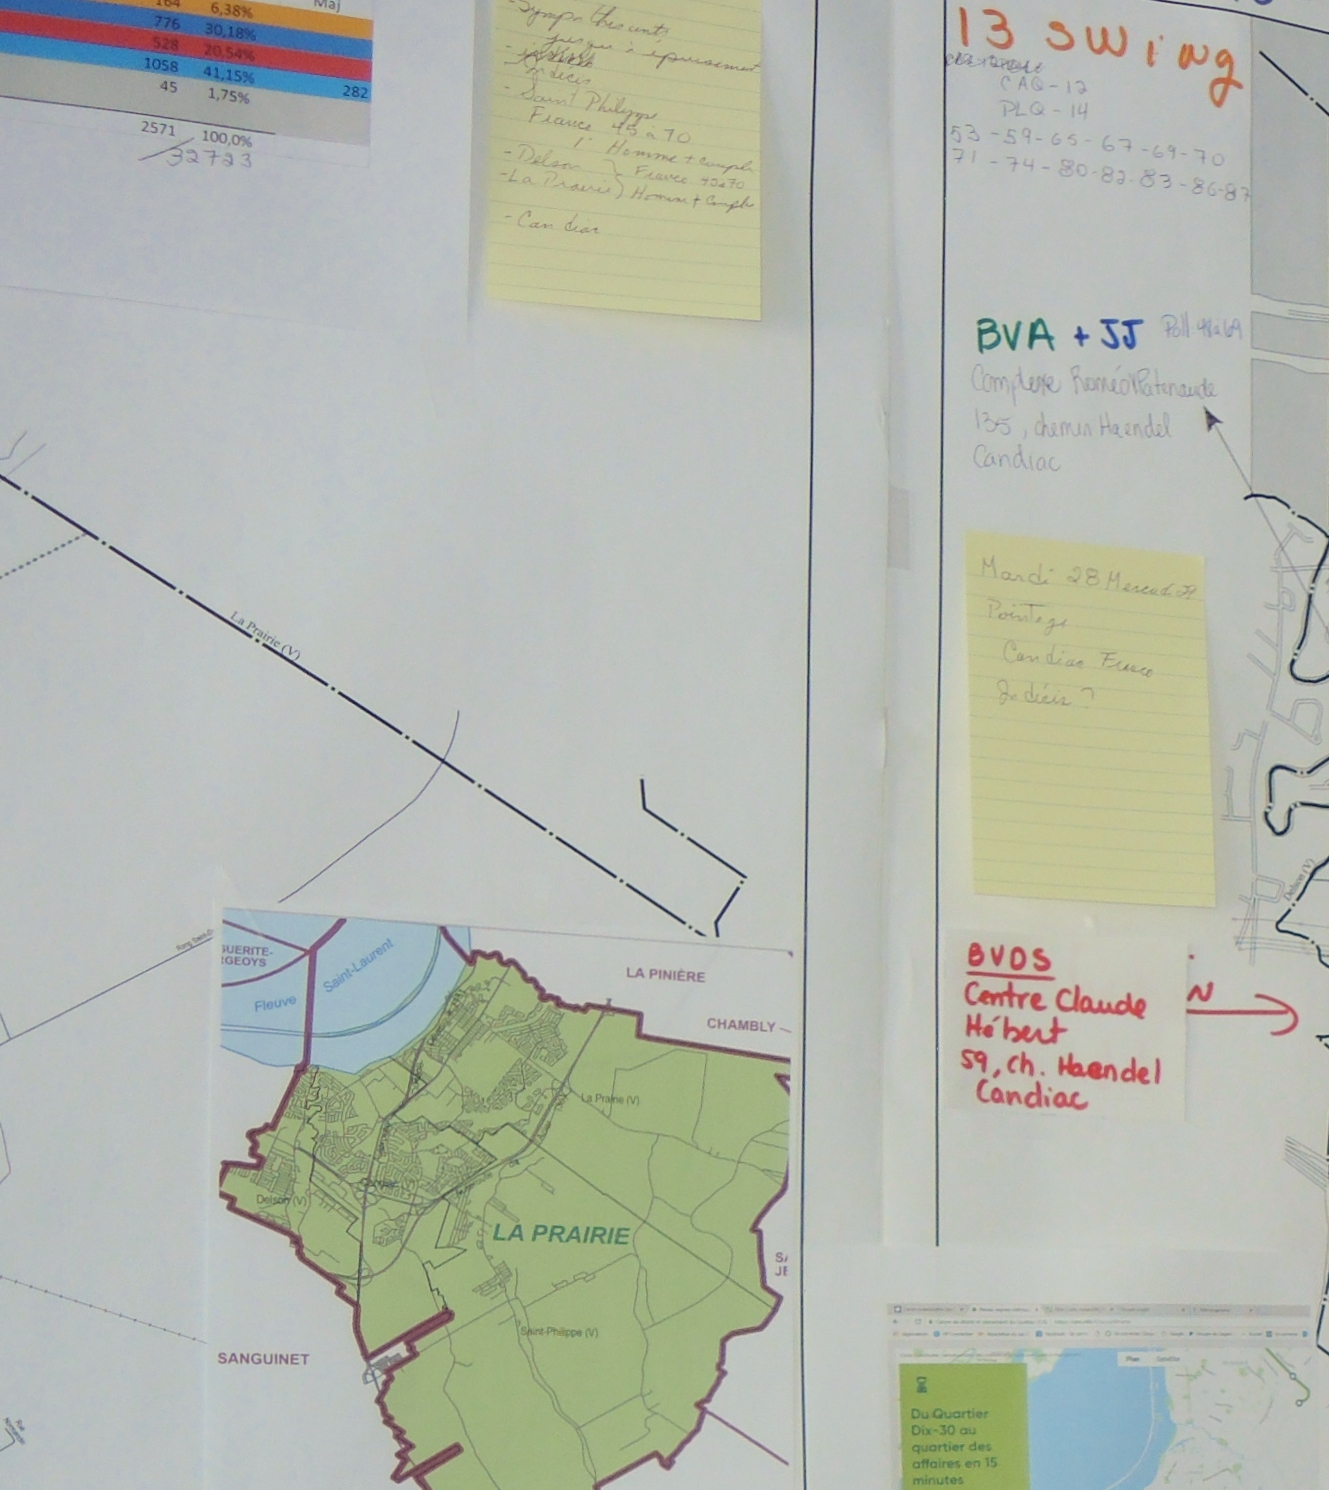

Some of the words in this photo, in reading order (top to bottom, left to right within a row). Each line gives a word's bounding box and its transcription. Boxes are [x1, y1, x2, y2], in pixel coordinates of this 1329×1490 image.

[210, 1, 253, 19] 6,38%
[155, 16, 181, 31] 776
[205, 22, 256, 41] 30,18%
[959, 6, 1014, 51] 13
[152, 36, 179, 51] 528
[144, 57, 179, 73] 1058
[203, 67, 255, 84] 41,15%
[343, 85, 369, 99] 282
[159, 81, 178, 94] 45
[208, 88, 251, 105] 1,75%
[141, 121, 176, 137] 2571
[202, 130, 252, 148] 100,0%
[977, 318, 1055, 353] BVA
[246, 621, 281, 647] Prairie
[968, 942, 1052, 972] BVDS
[254, 996, 297, 1013] Fleuve
[323, 938, 394, 993] Saint-Laurent
[627, 967, 645, 979] LA
[649, 968, 706, 983] PINIÈRE
[964, 981, 1048, 1011] Centre
[1056, 984, 1147, 1020] Claude
[707, 1017, 776, 1033] CHAMBLY
[966, 1013, 1069, 1044] Hébert
[1058, 1052, 1161, 1085] Haendel
[977, 1078, 1088, 1110] Candiac
[493, 1223, 524, 1241] LA
[532, 1224, 630, 1245] PRAIRIE
[218, 1352, 310, 1366] SANGUINET
[911, 1408, 929, 1419] Du
[933, 1408, 989, 1419] Quartier
[911, 1425, 955, 1435] Dix-30
[960, 1427, 976, 1435] au
[912, 1442, 965, 1453] quartier
[969, 1441, 992, 1451] des
[912, 1459, 961, 1469] affaires
[965, 1459, 981, 1468] en
[985, 1457, 998, 1467] 15
[913, 1475, 964, 1485] minutes
